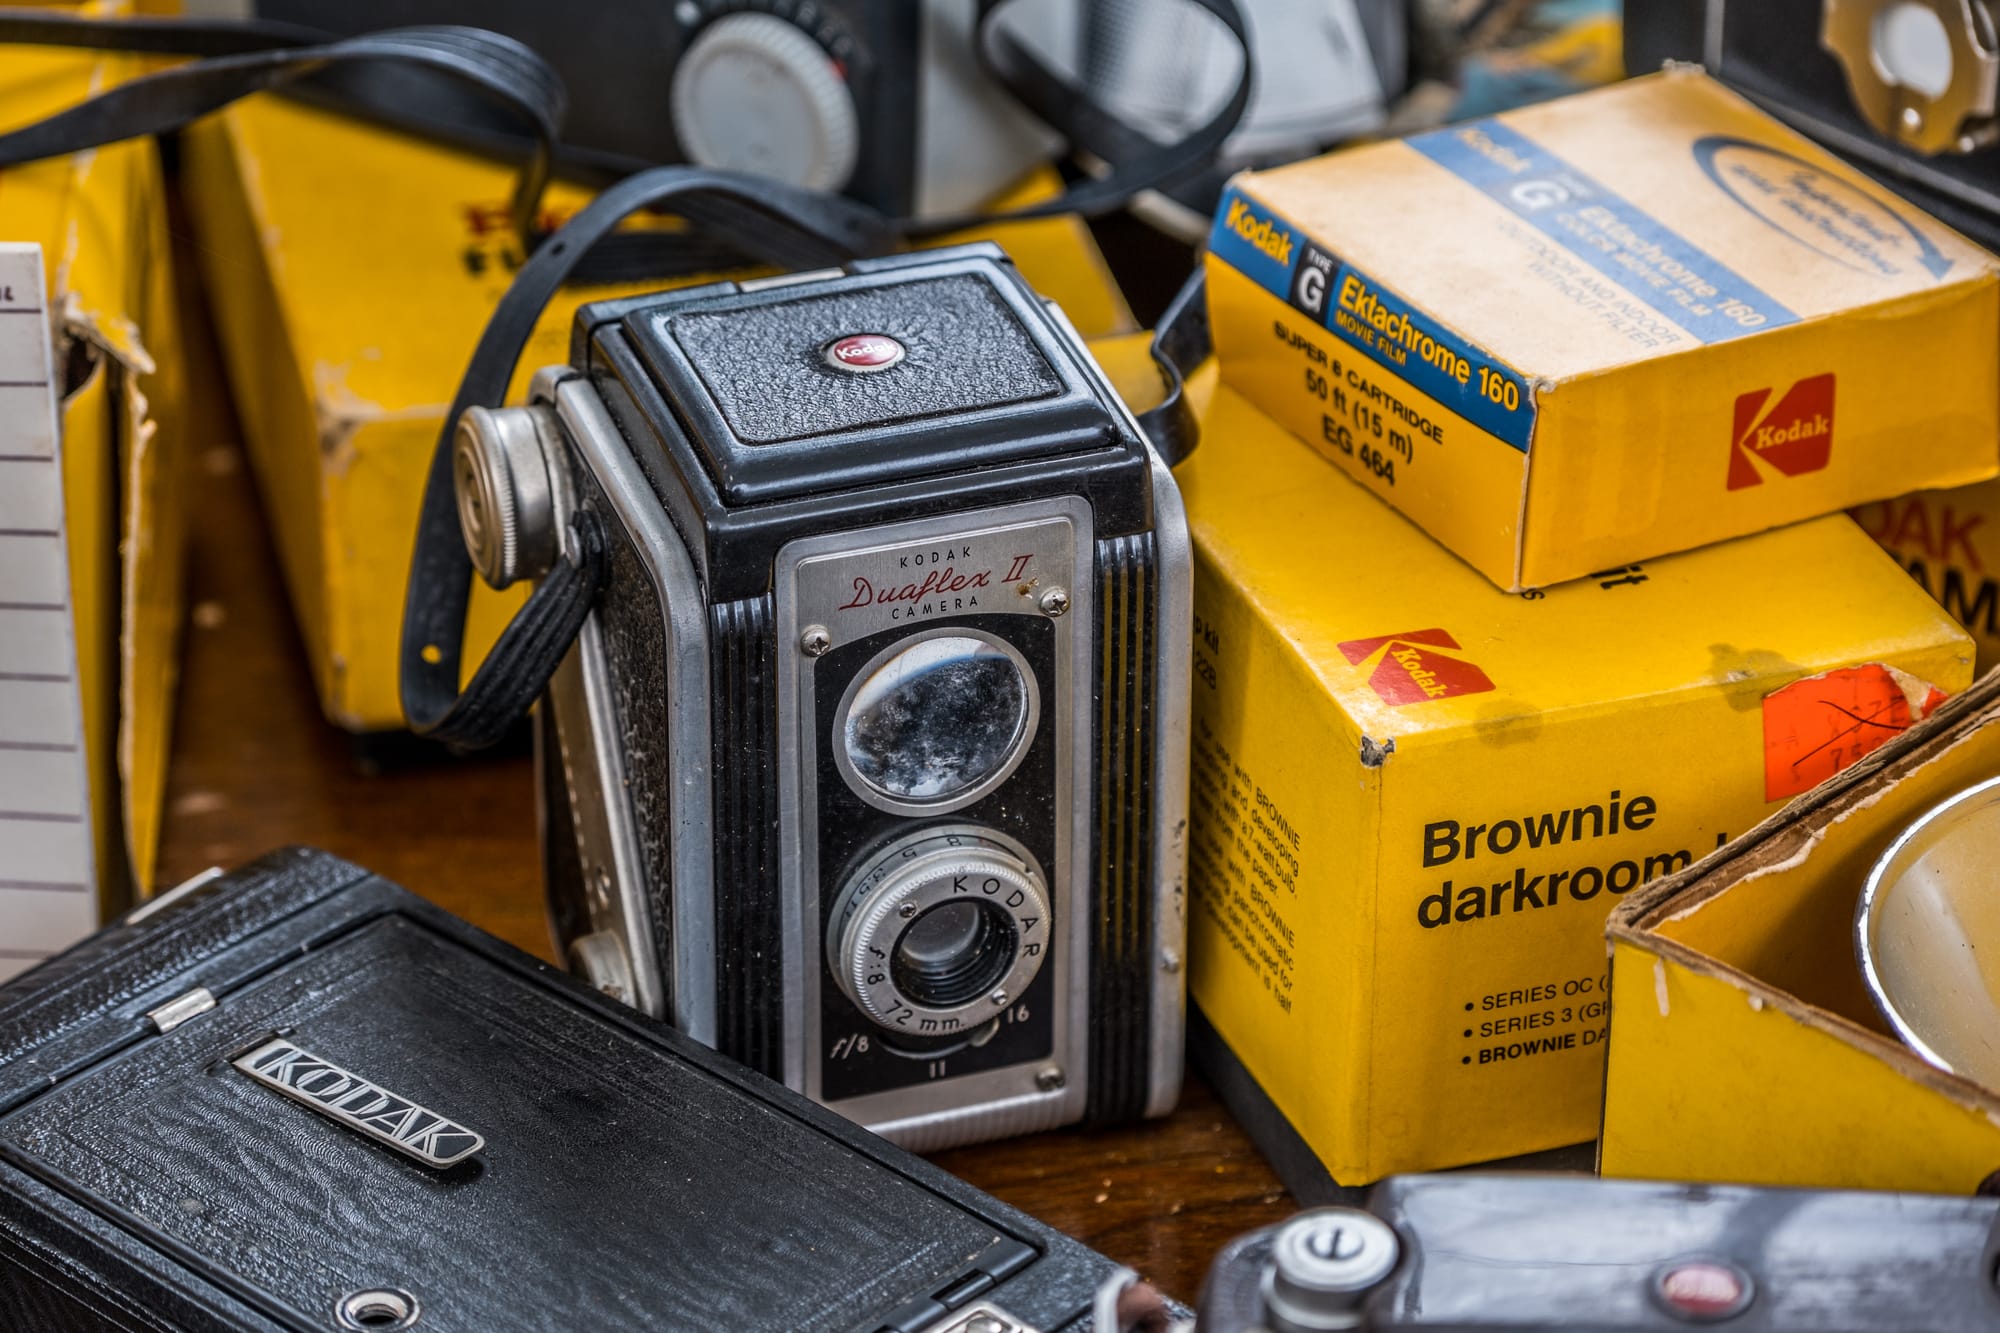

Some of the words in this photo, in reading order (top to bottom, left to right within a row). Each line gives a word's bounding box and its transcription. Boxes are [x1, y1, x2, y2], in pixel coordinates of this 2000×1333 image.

[1226, 198, 1294, 267] Kodak
[1297, 265, 1326, 316] G
[1576, 203, 1718, 297] Ektachrome
[1715, 296, 1768, 328] 160
[1578, 272, 1616, 301] AND
[1617, 299, 1682, 345] INDOOR
[1666, 286, 1714, 317] FILM
[836, 340, 898, 360] Kodak
[1334, 308, 1376, 346] MOVIE
[1378, 334, 1408, 367] FILM
[1338, 274, 1472, 384] Ektachrome
[1477, 366, 1521, 412] 160
[1600, 309, 1660, 350] FILTER
[1273, 319, 1328, 371] SUPER
[1331, 359, 1343, 379] 8
[1345, 368, 1445, 446] CARTRIDGE
[1304, 367, 1329, 401] 50
[1332, 384, 1349, 416] ft
[1353, 400, 1384, 440] (15
[1387, 421, 1415, 465] m)
[1755, 413, 1830, 450] Kodak
[1321, 413, 1354, 458] EG
[1358, 441, 1397, 487] 464
[899, 545, 971, 569] KODAK
[837, 566, 992, 612] Duaflex
[891, 595, 979, 620] CAMERA
[1391, 647, 1448, 698] Kodak
[1231, 783, 1249, 811] and
[1251, 807, 1299, 878] developing
[1255, 786, 1301, 852] BROWNIE
[1422, 790, 1657, 868] Brownie
[1417, 848, 1692, 930] darkroom
[953, 875, 1041, 959] KODAR
[1250, 882, 1295, 949] BROWNIE
[885, 998, 914, 1026] 72
[1006, 1003, 1030, 1024] 16
[1481, 984, 1557, 1012] SERIES
[1563, 977, 1593, 996] OC
[829, 1032, 869, 1060] f/8
[1479, 1009, 1555, 1038] SERIES
[1561, 1006, 1573, 1022] 3
[928, 1060, 947, 1079] 11
[1478, 1033, 1577, 1065] BROWNIE
[254, 1047, 477, 1159] KODAK
